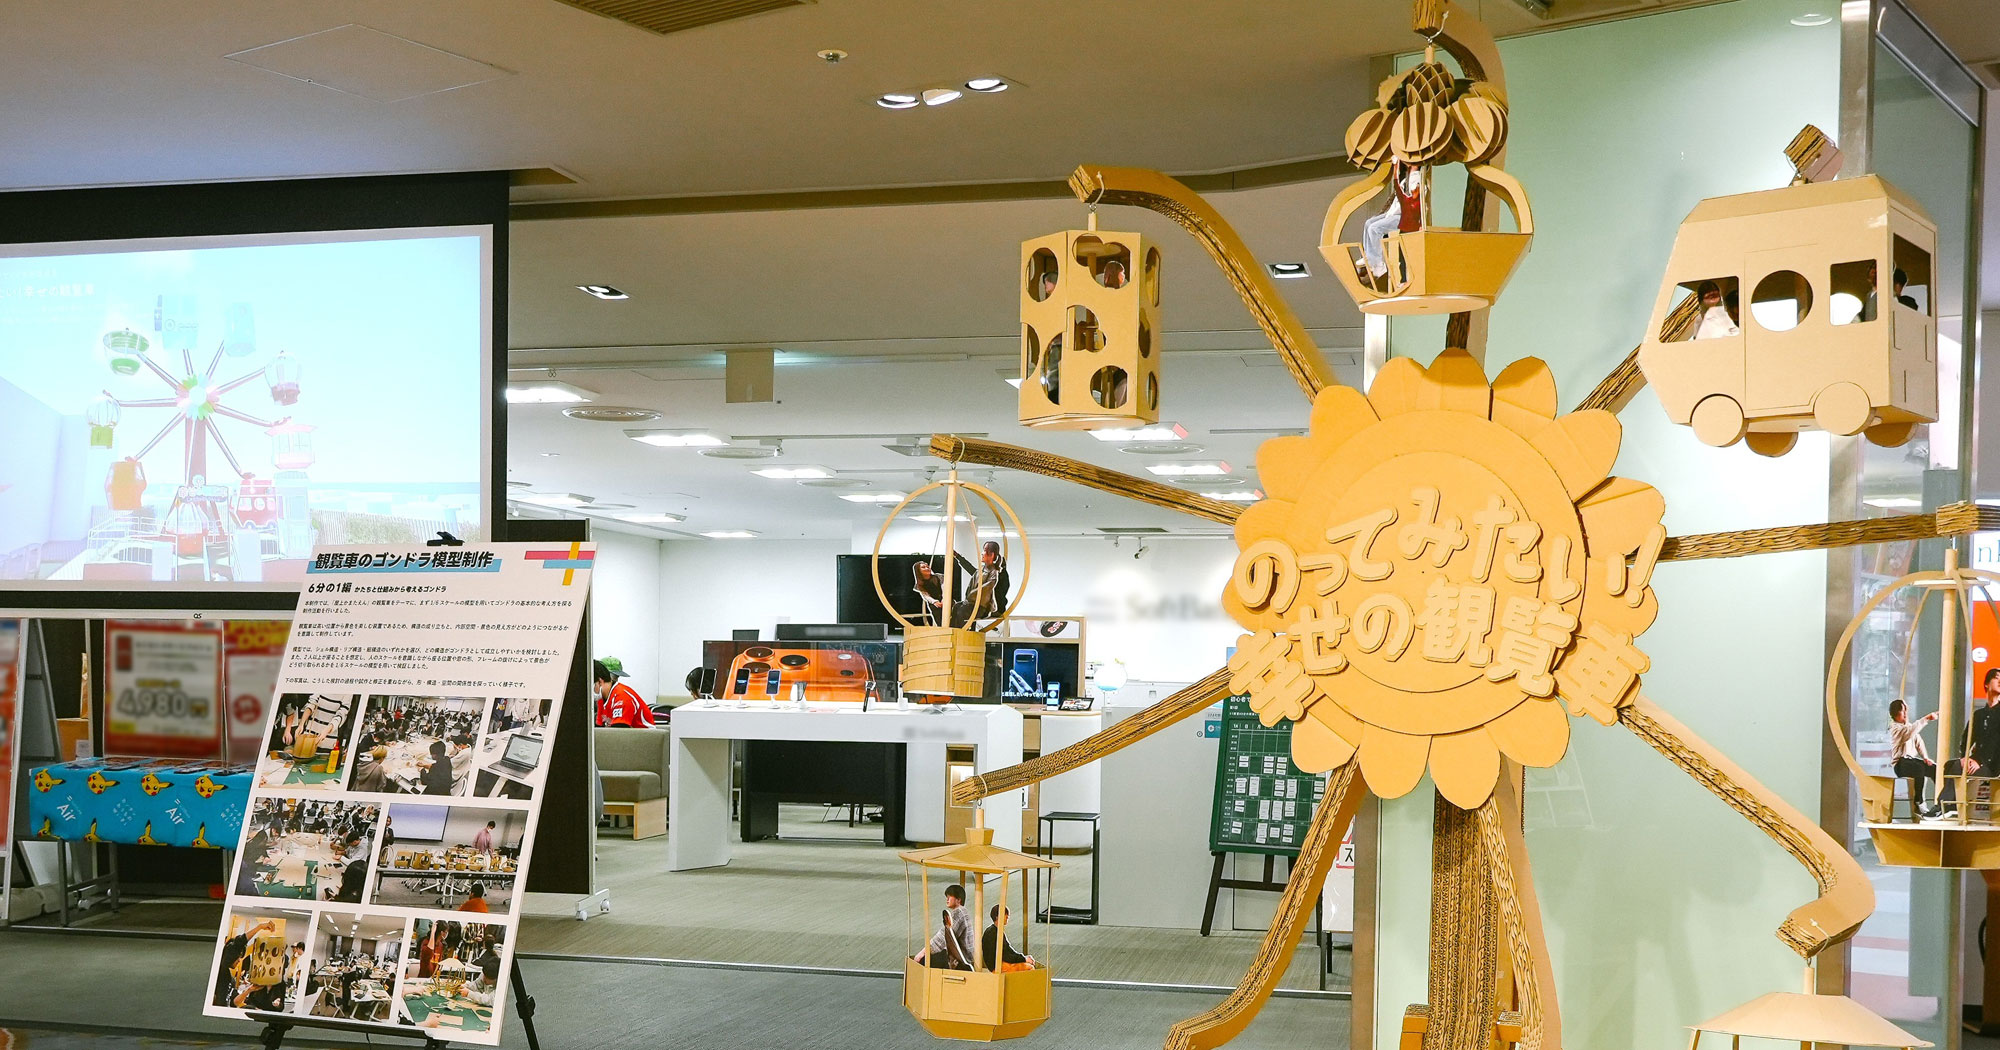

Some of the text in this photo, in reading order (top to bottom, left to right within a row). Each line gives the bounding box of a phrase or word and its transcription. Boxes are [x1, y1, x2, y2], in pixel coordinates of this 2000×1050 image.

[314, 551, 494, 570] 観覧車のゴンドラ模型制作
[1228, 574, 1651, 726] 幸せの観覧車
[56, 804, 76, 821] Air
[165, 807, 186, 826] Air
